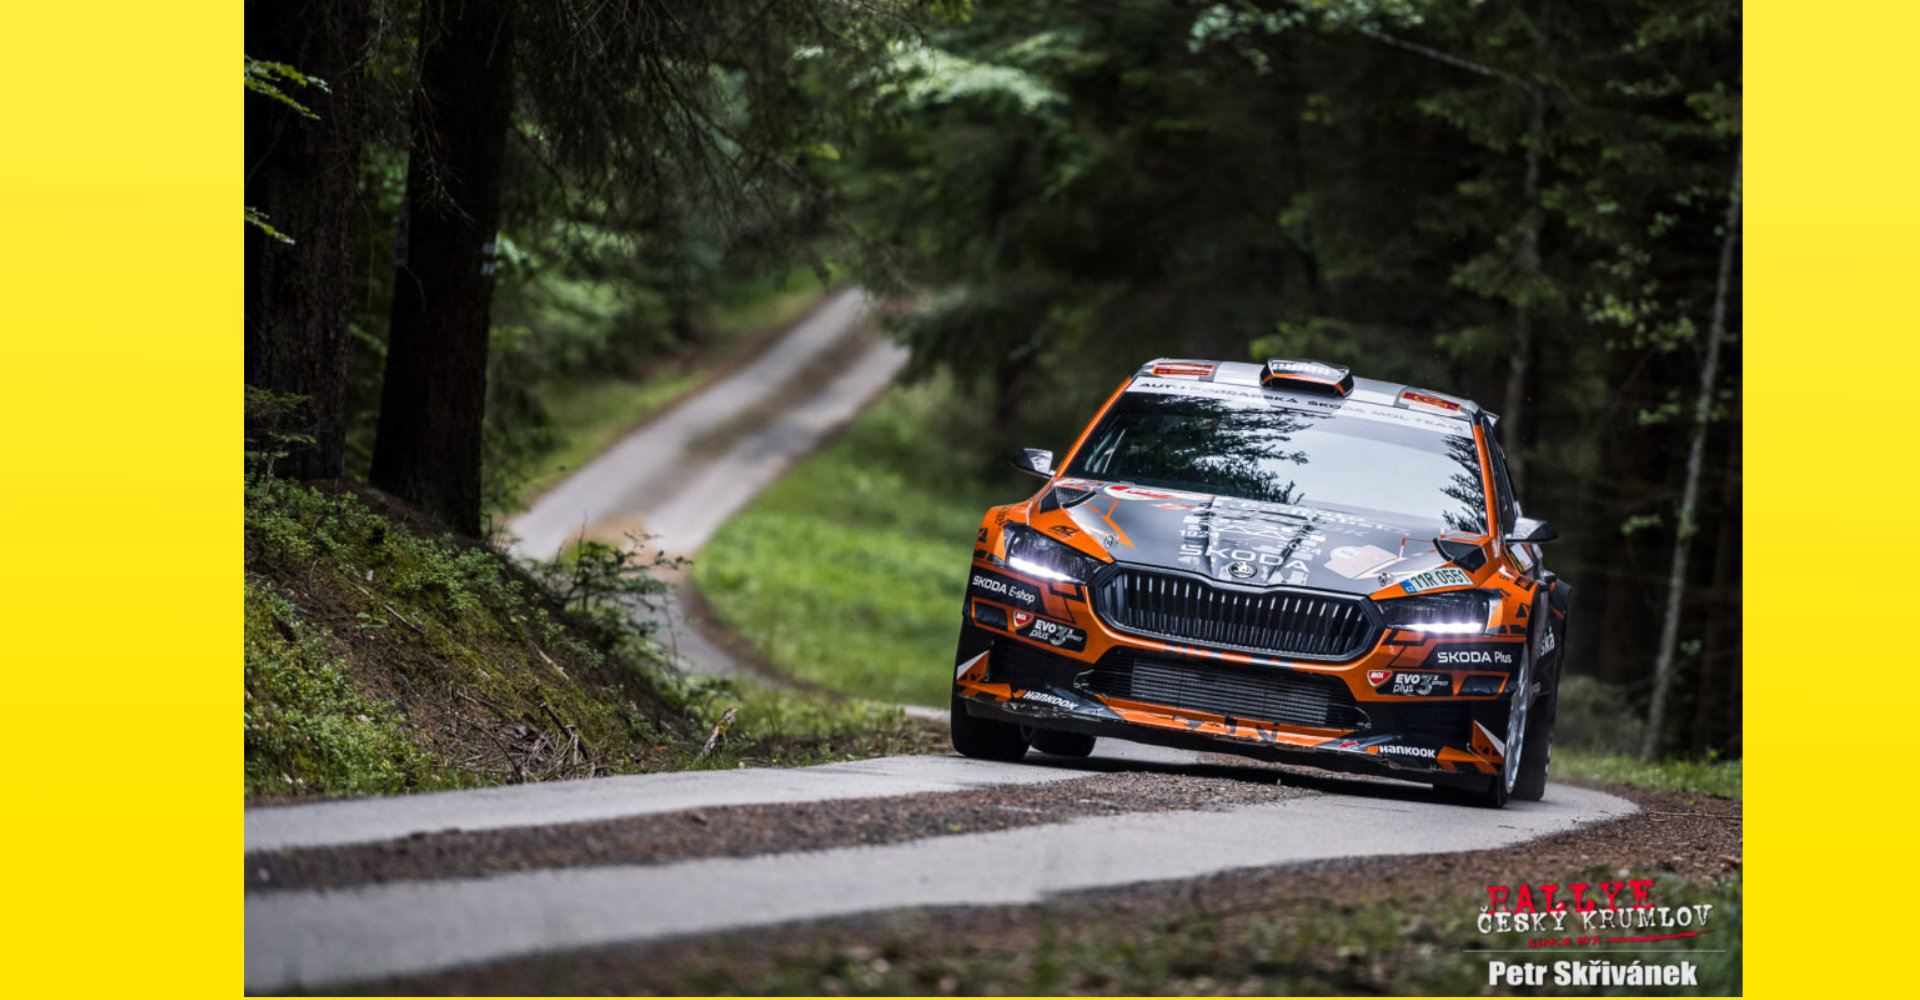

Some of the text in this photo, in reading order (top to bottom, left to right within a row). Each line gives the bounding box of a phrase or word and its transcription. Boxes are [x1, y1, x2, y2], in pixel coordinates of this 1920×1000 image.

[1411, 572, 1440, 588] 11R
[1435, 569, 1470, 584] 0551
[1008, 585, 1036, 605] E-shop
[1035, 619, 1057, 633] EVO
[1029, 628, 1049, 640] plus
[1494, 651, 1513, 664] Plus
[1395, 673, 1420, 684] EVO
[1393, 681, 1414, 694] plus
